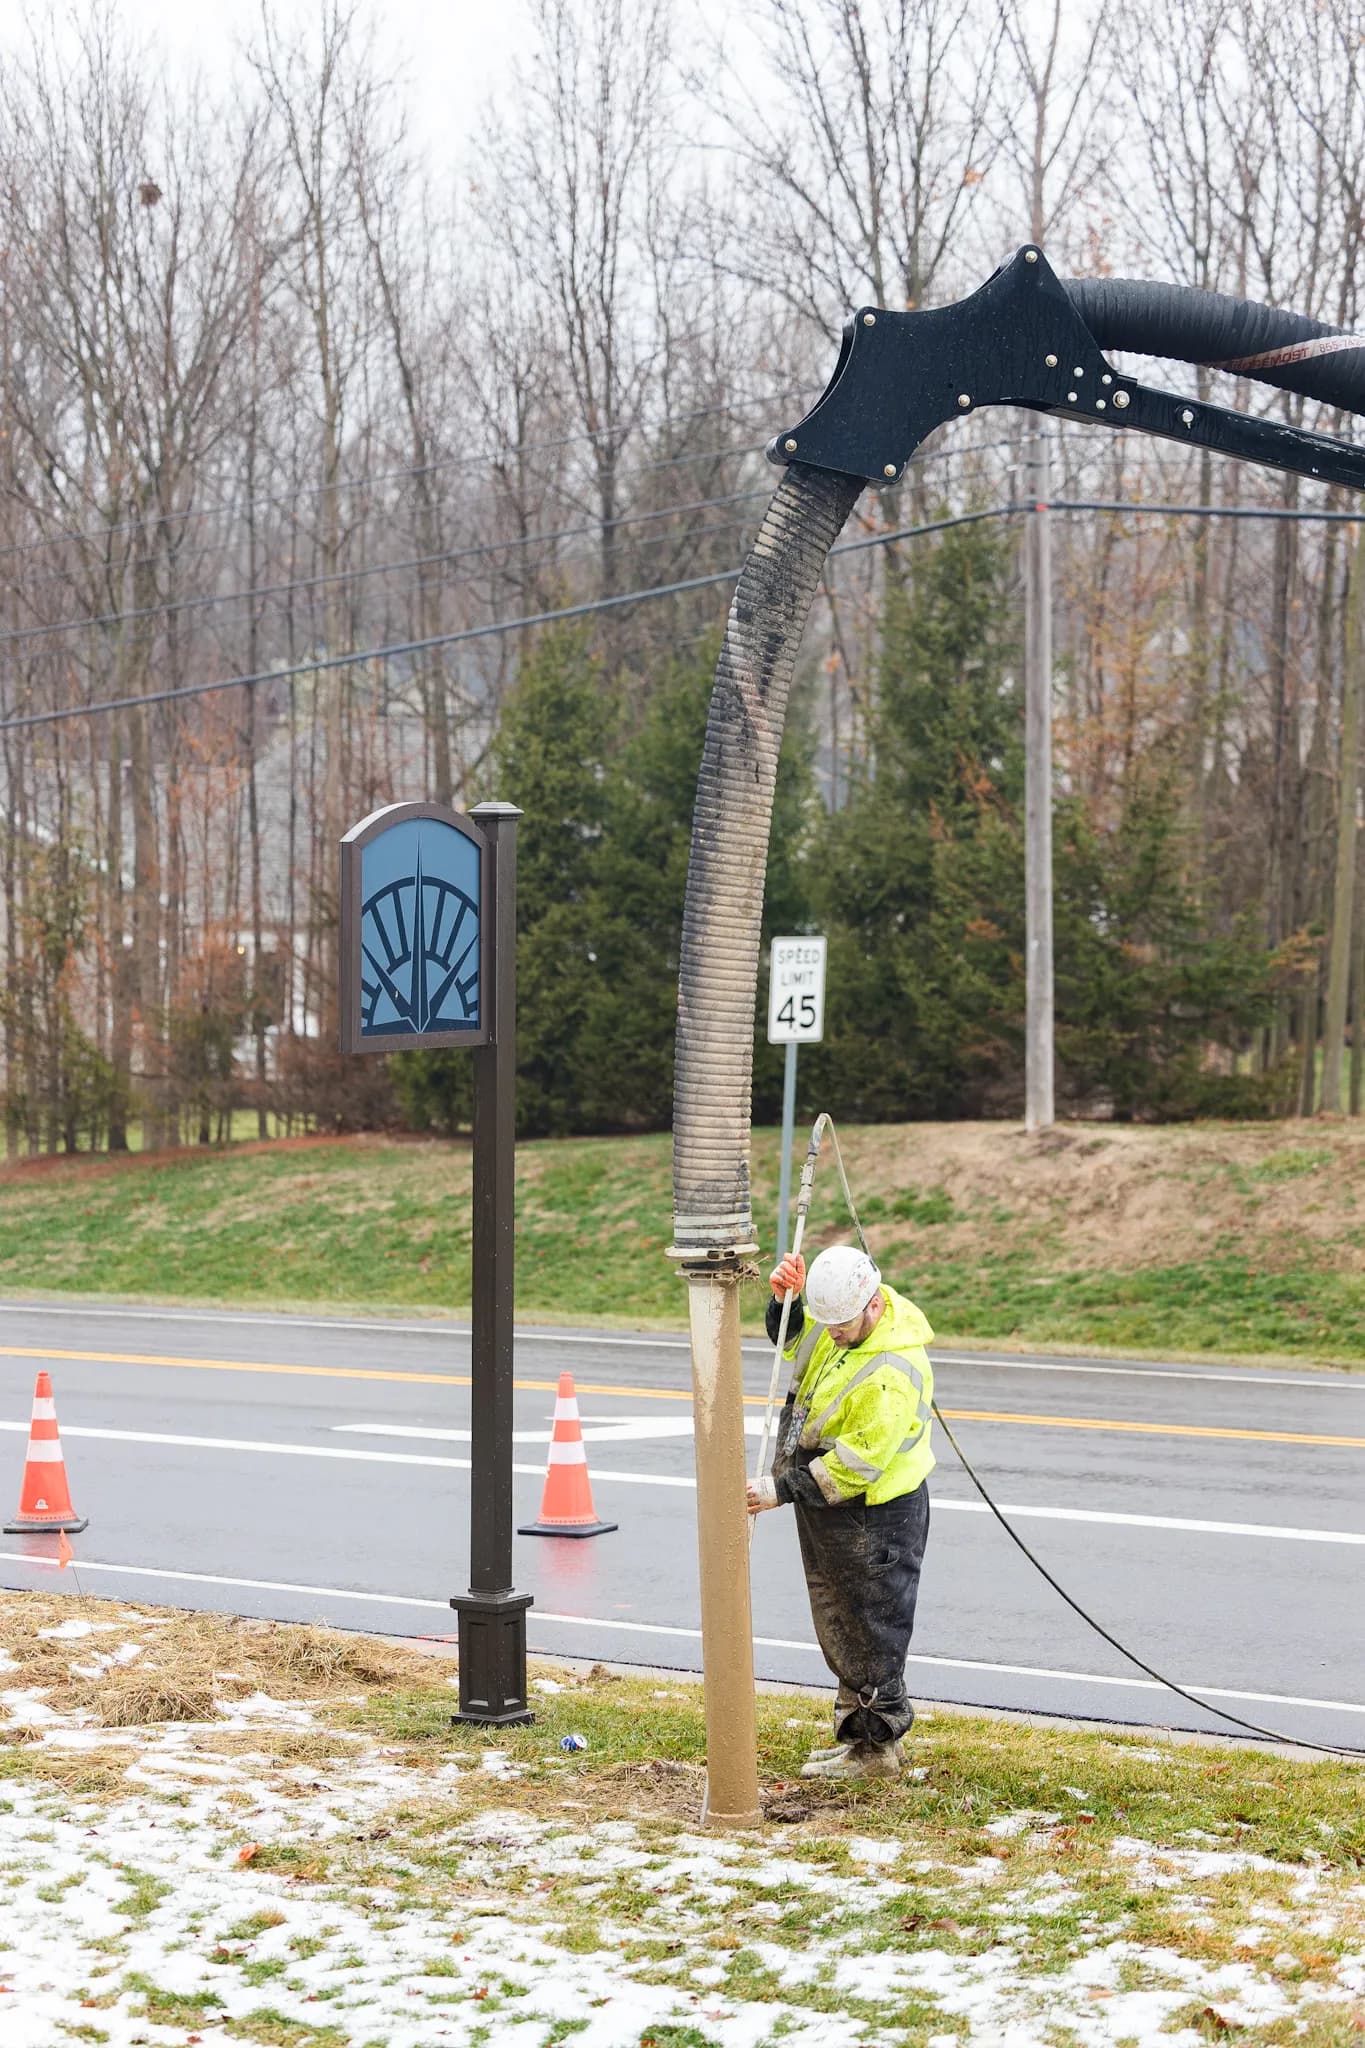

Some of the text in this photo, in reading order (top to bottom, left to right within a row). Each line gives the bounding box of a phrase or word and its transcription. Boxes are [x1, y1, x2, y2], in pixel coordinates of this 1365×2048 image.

[777, 948, 820, 964] SPEED
[780, 970, 814, 986] LIMIT
[777, 995, 816, 1029] 45
